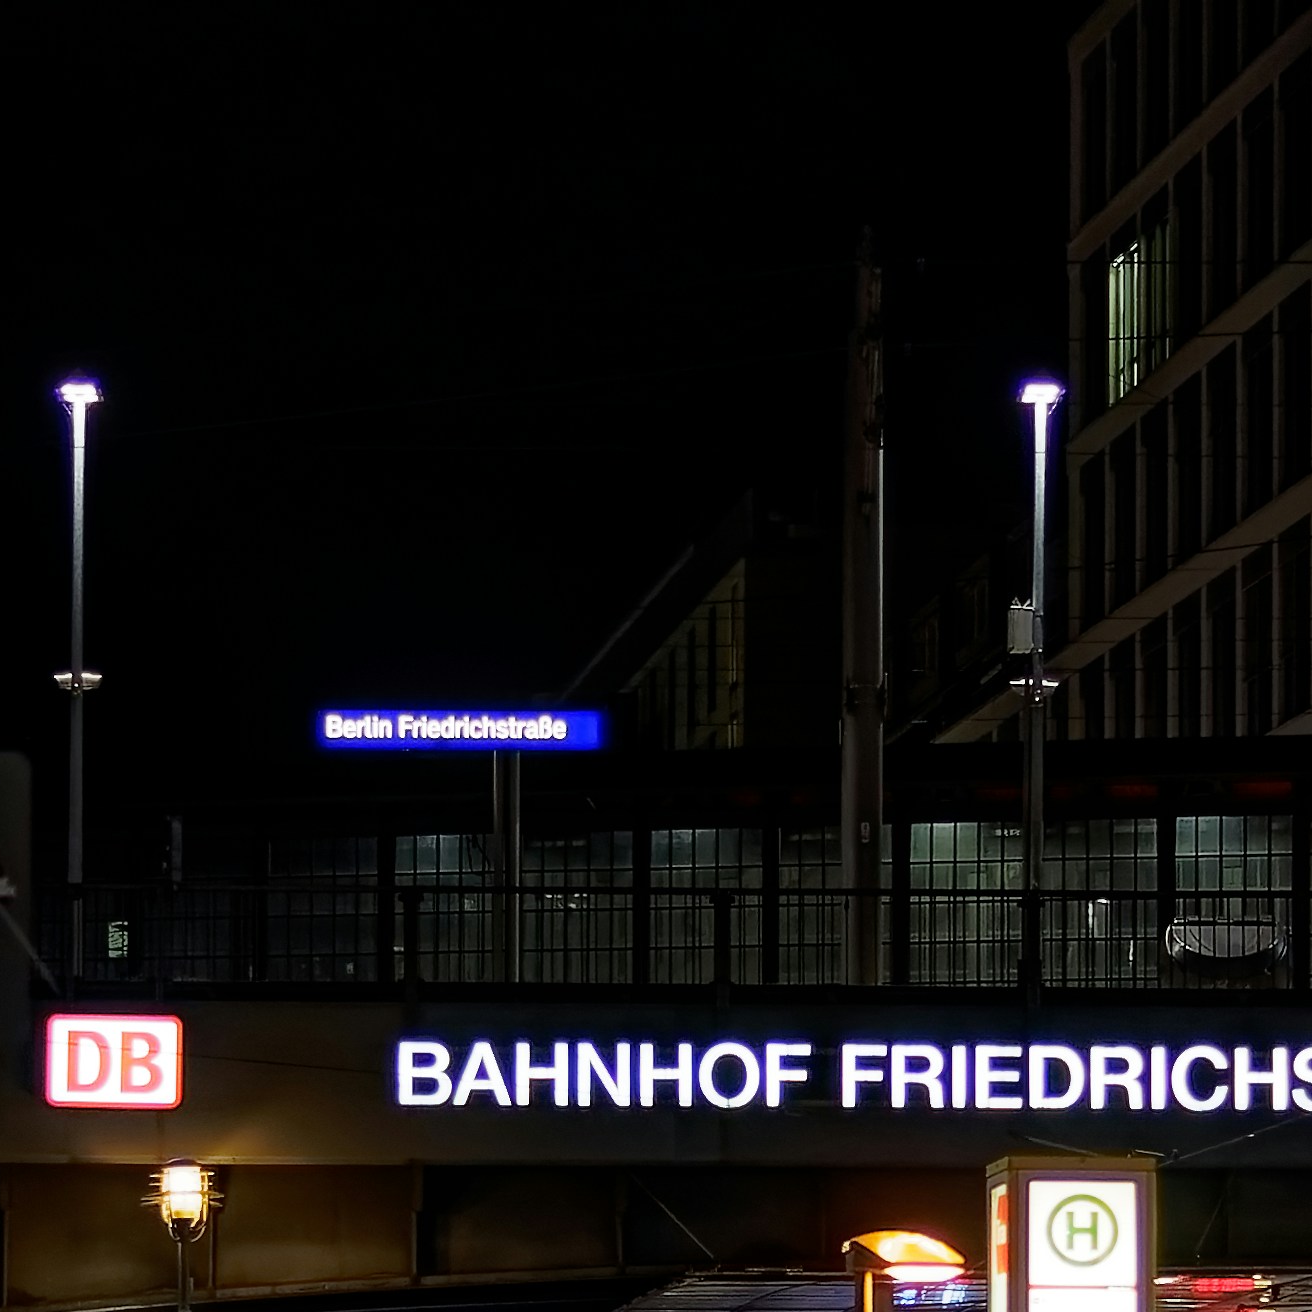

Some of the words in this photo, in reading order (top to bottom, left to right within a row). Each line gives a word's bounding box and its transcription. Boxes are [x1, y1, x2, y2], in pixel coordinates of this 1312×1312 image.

[324, 714, 393, 739] Berlin
[397, 715, 568, 740] Friedrichstraße
[67, 1030, 164, 1094] DB
[397, 1041, 814, 1109] BAHNHOF
[1065, 1211, 1099, 1250] H
